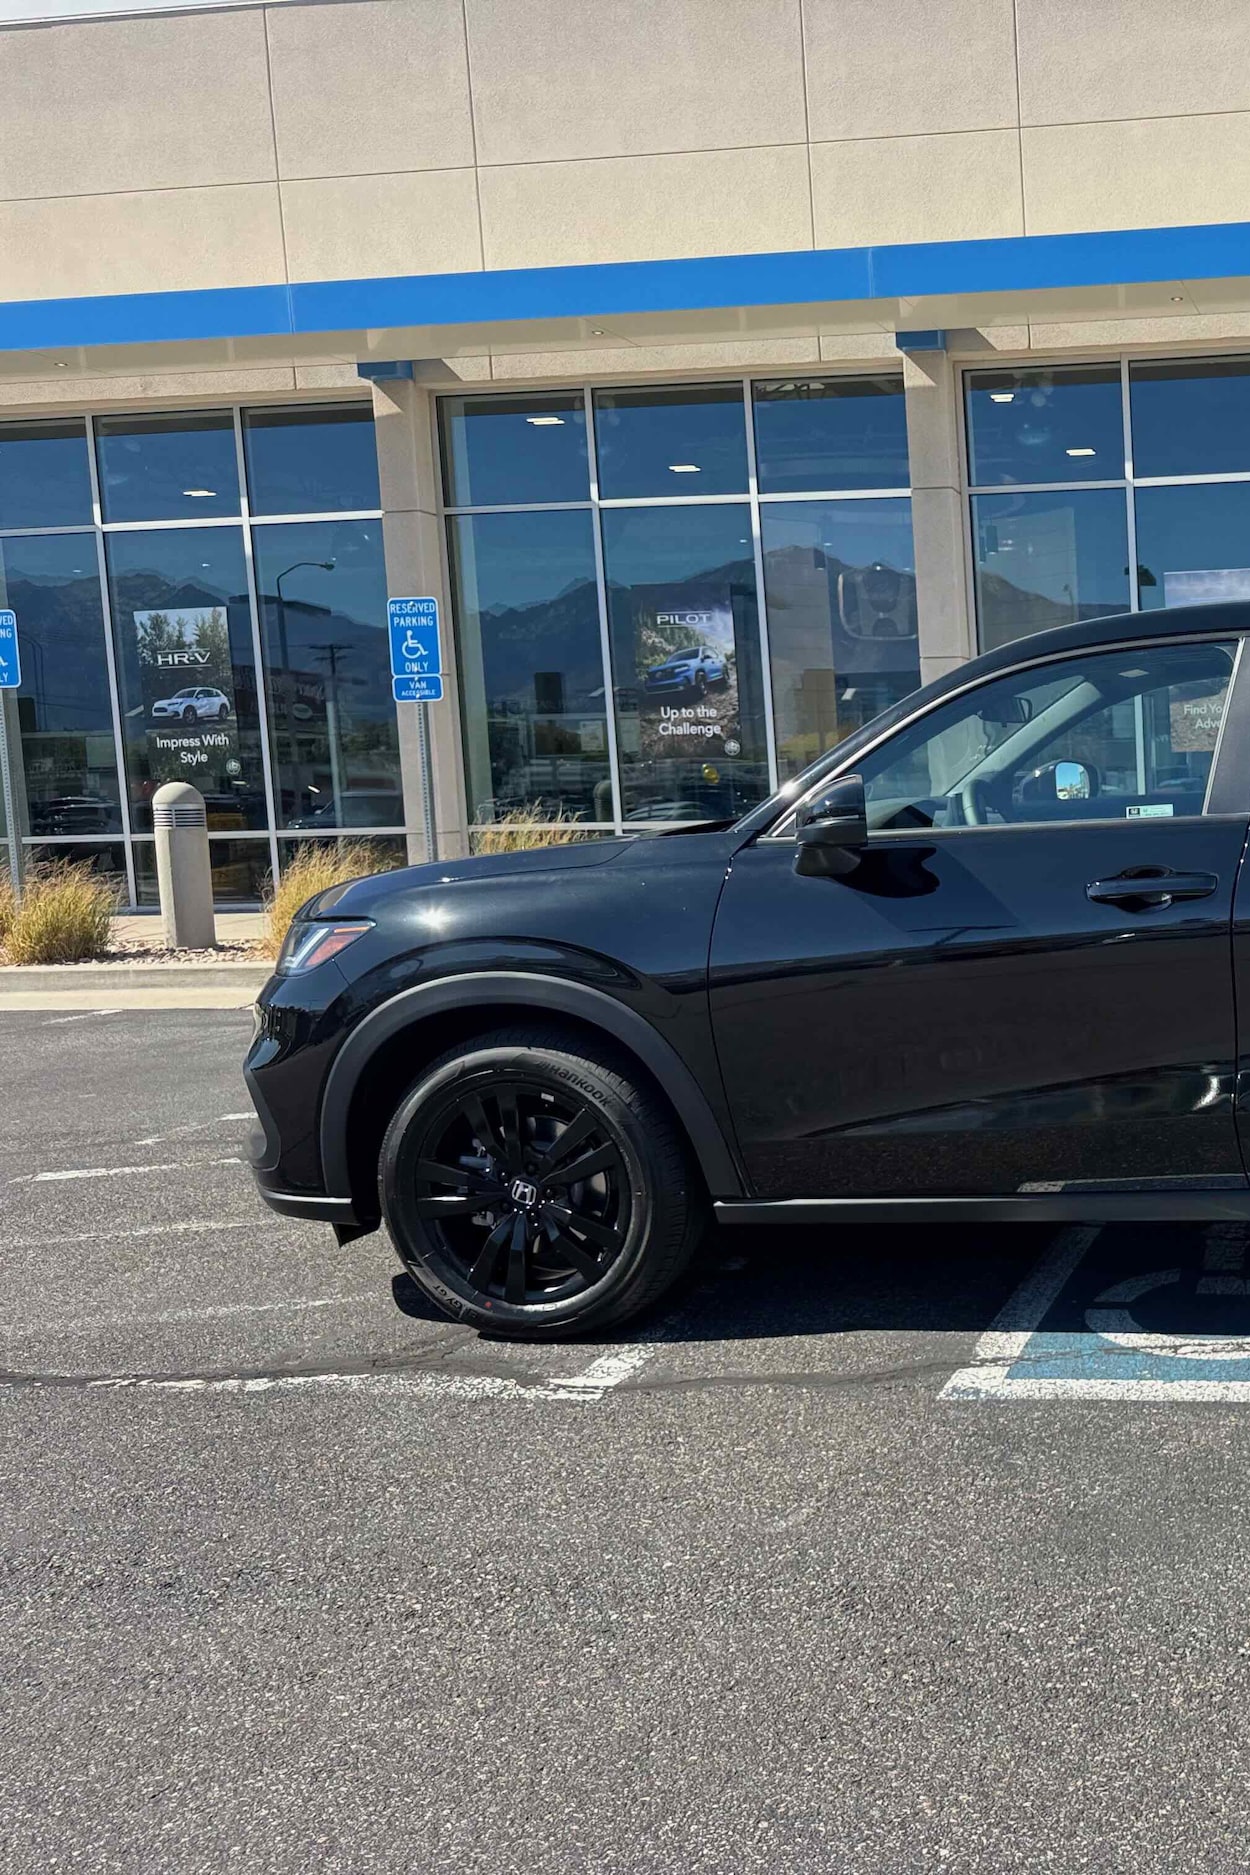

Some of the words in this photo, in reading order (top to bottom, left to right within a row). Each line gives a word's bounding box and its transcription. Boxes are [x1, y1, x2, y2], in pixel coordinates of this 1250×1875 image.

[390, 602, 436, 614] RESERVED
[393, 616, 434, 627] PARKING
[657, 614, 711, 625] PILOT
[157, 651, 211, 666] HR-V
[405, 662, 429, 673] ONLY
[409, 681, 427, 689] VAN
[401, 689, 436, 697] ACCESSIBLE
[660, 706, 679, 721] Up
[682, 707, 694, 718] to
[697, 706, 718, 718] the
[1184, 704, 1207, 715] Find
[1208, 703, 1223, 714] Yo
[658, 722, 722, 738] Challenge
[156, 736, 200, 751] Impress
[203, 733, 230, 746] With
[180, 751, 208, 767] Style
